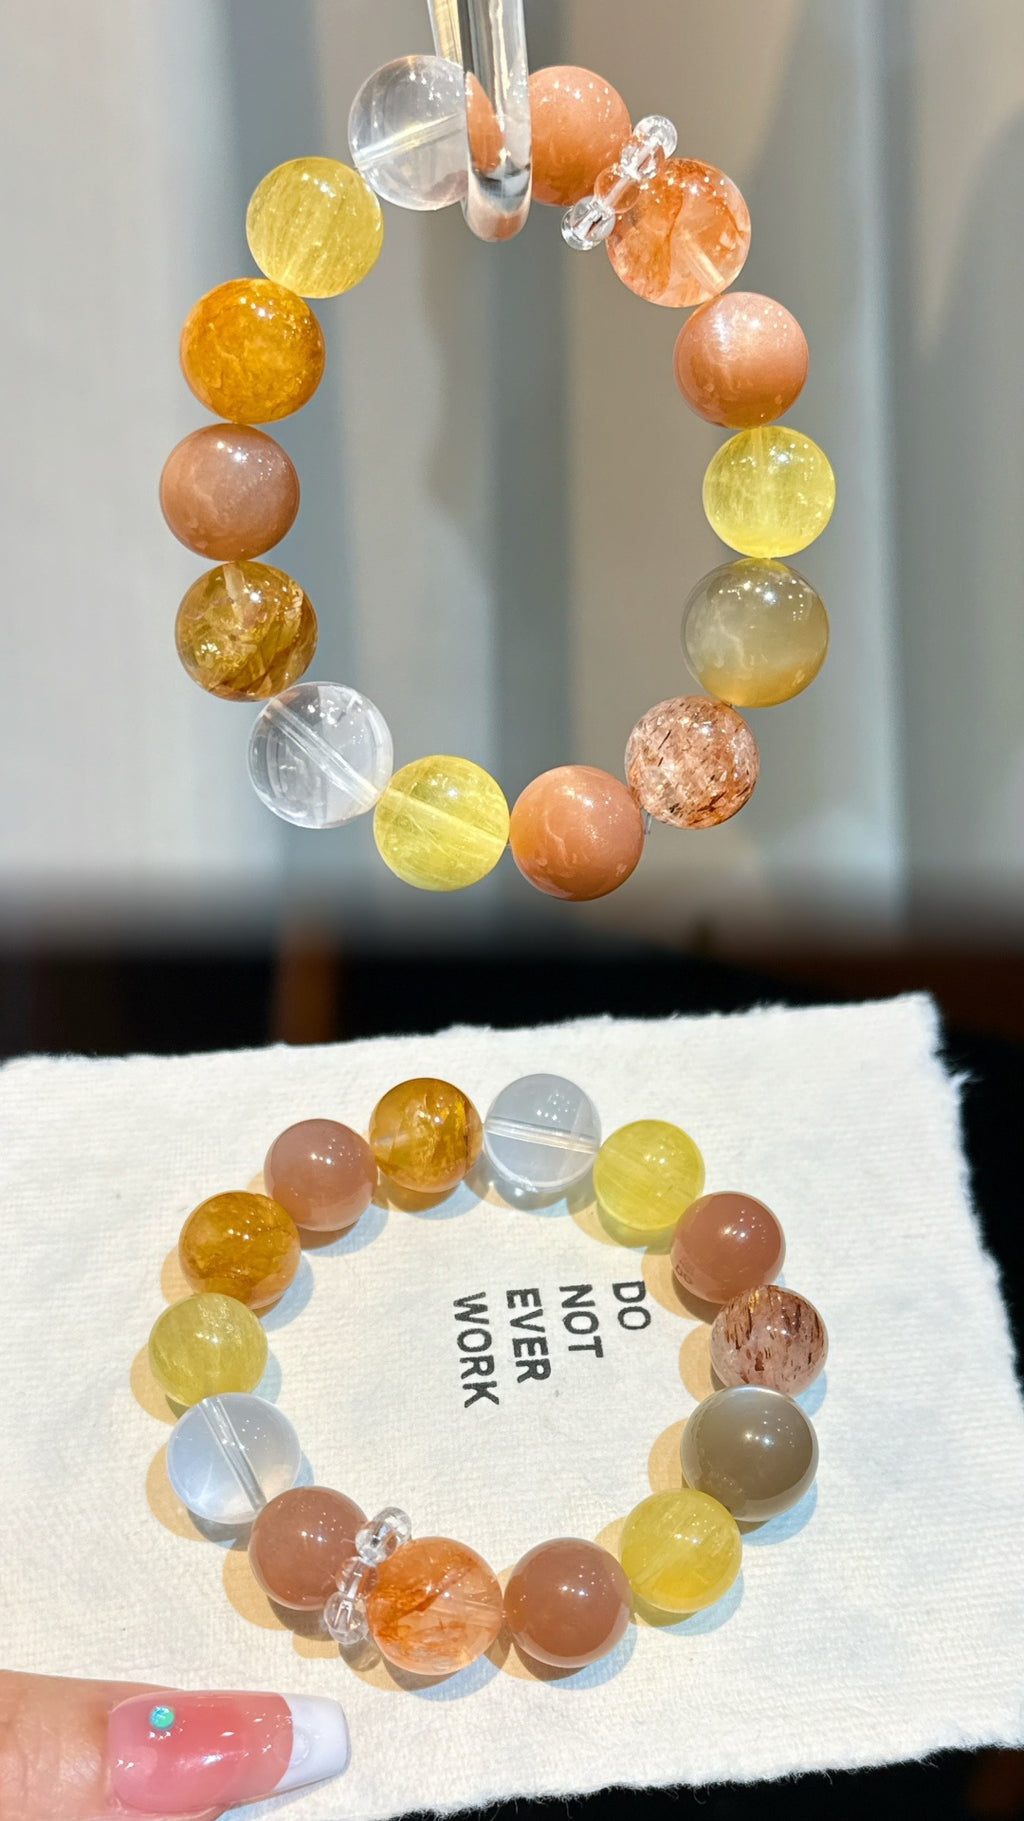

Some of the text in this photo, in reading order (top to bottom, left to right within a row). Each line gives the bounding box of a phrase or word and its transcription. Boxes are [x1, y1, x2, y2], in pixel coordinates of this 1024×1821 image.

[506, 1288, 552, 1384] EVER
[560, 1284, 604, 1358] NOT
[612, 1280, 652, 1330] DO
[453, 1292, 500, 1409] WORK
